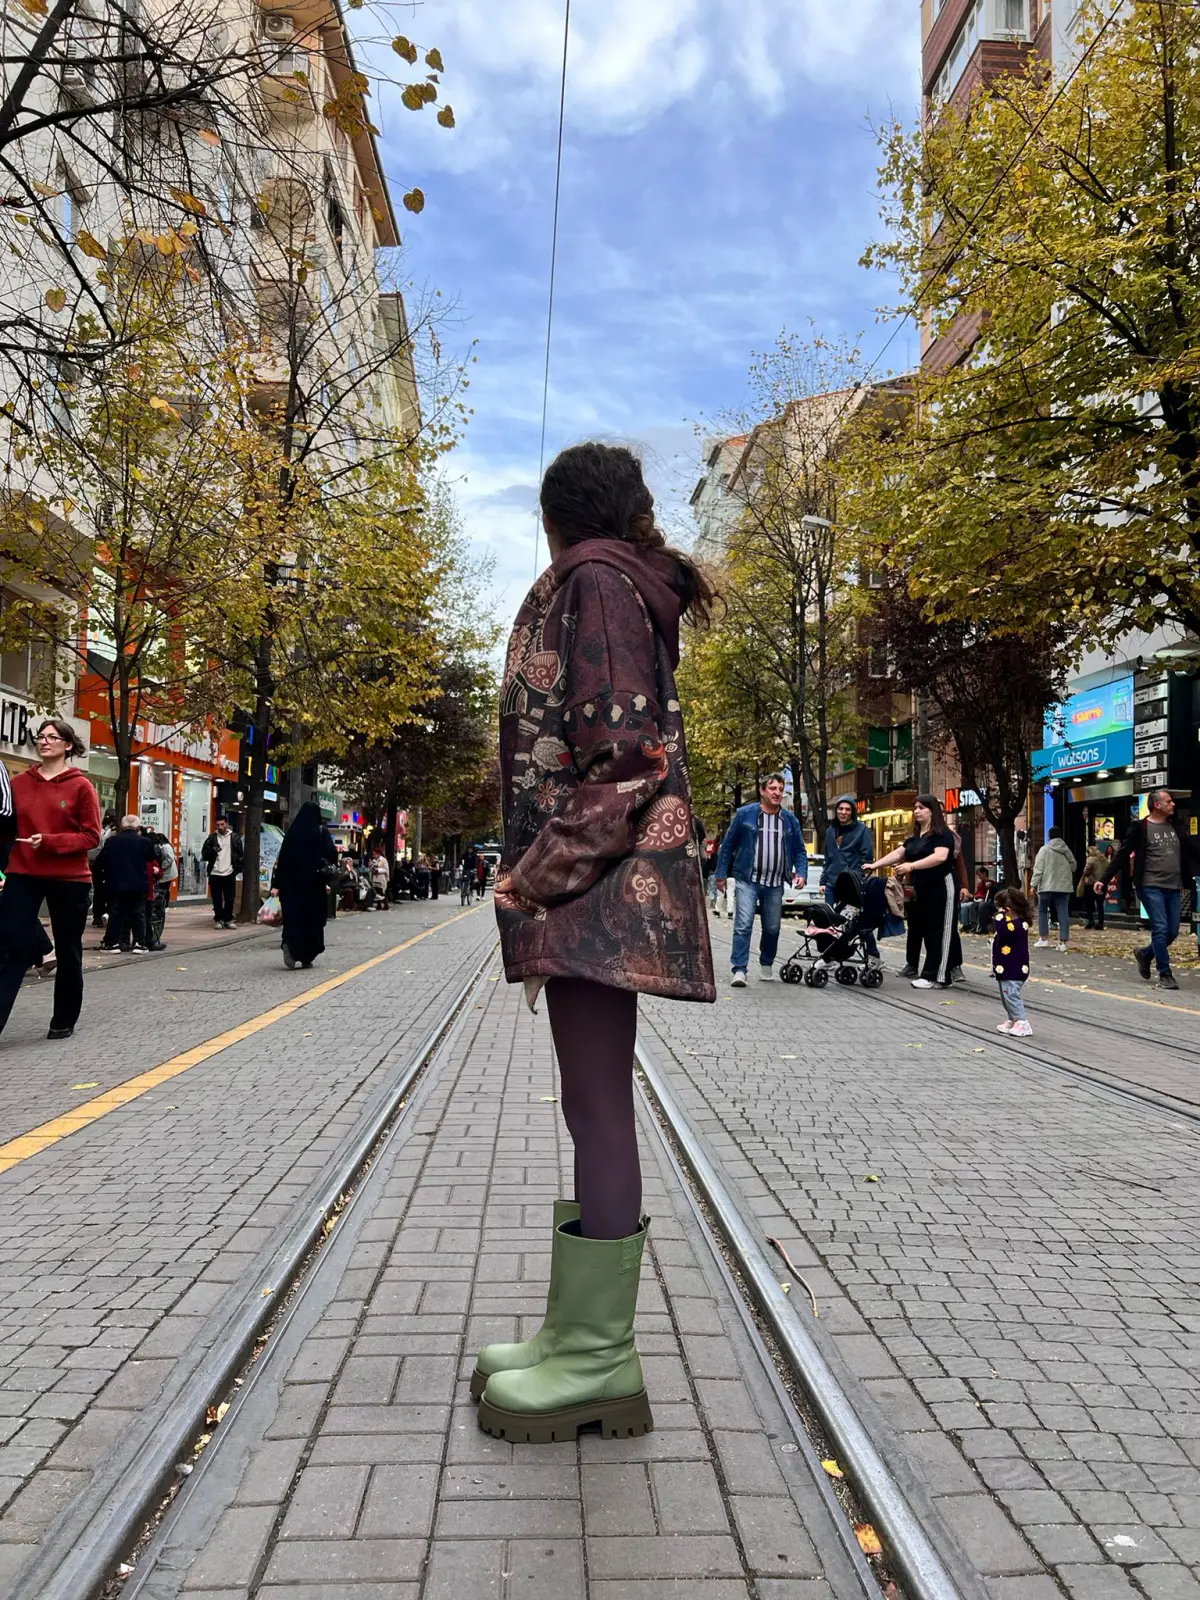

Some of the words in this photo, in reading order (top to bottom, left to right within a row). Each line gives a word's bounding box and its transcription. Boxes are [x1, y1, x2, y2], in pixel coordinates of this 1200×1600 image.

[1057, 747, 1100, 768] watsons
[946, 788, 959, 812] IN
[960, 787, 988, 807] STRET
[1153, 831, 1176, 839] GAP
